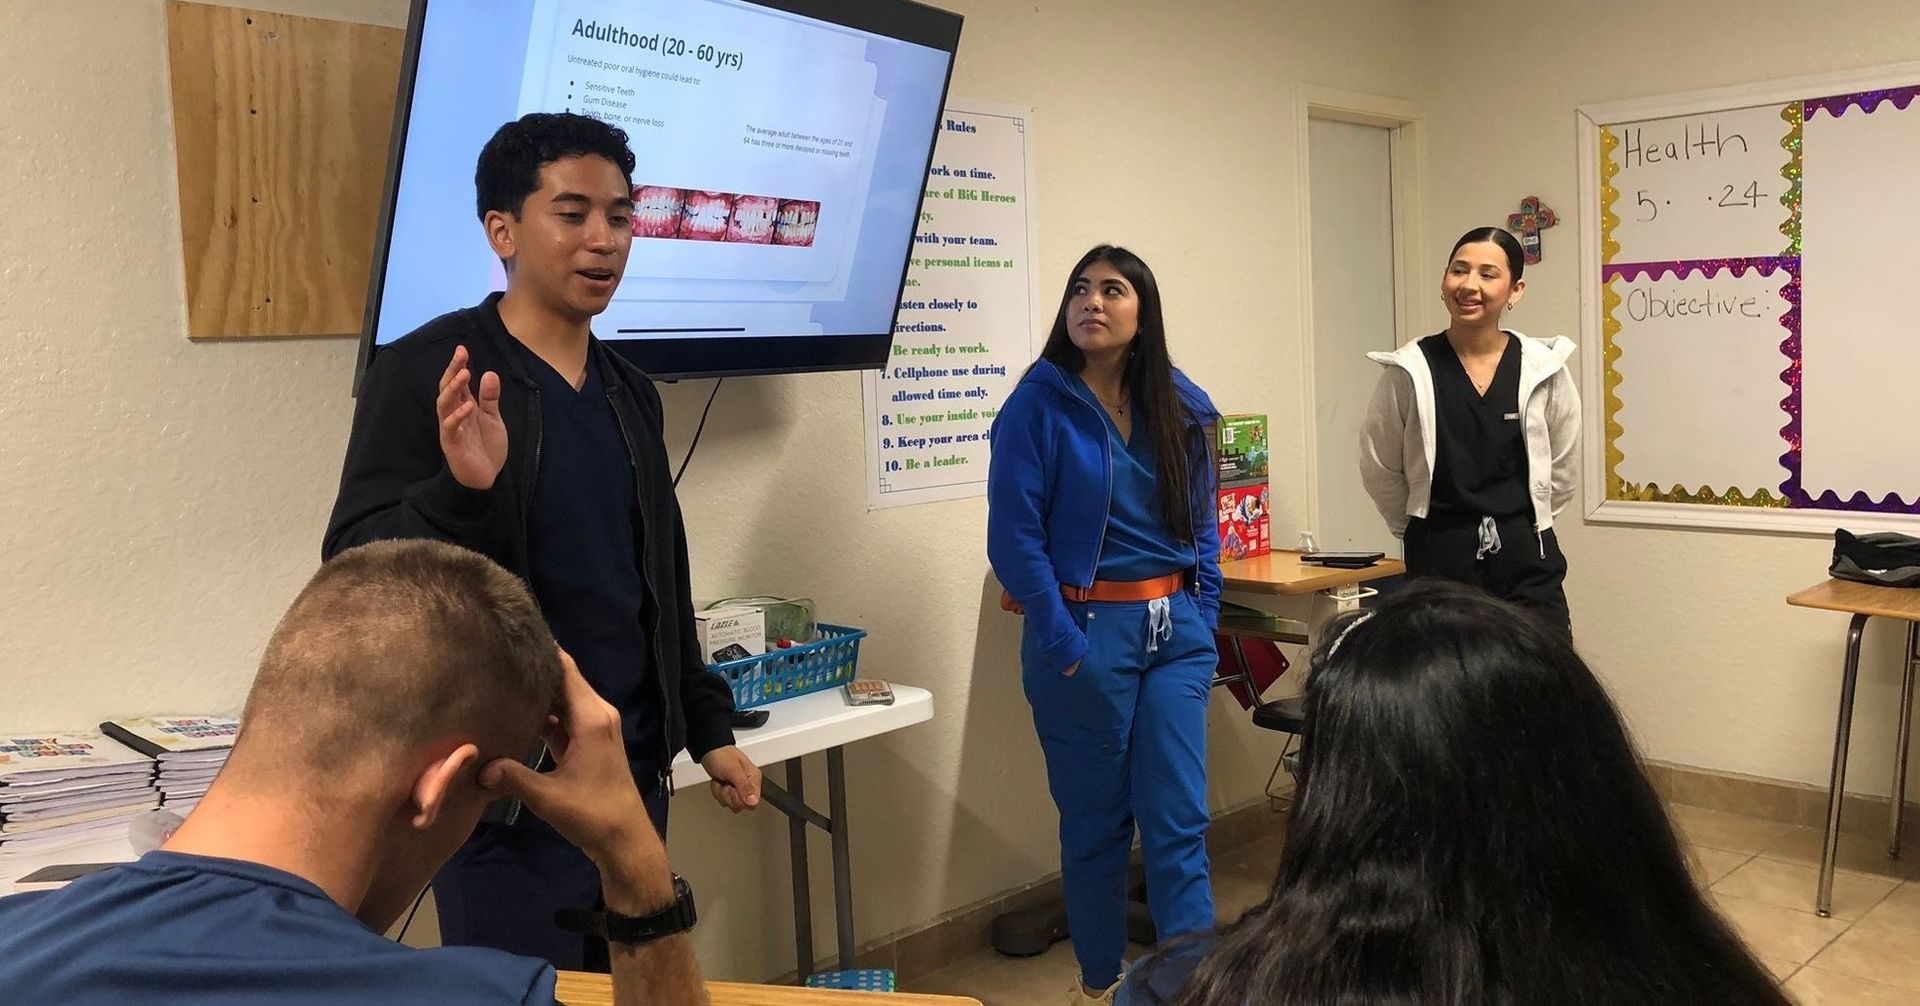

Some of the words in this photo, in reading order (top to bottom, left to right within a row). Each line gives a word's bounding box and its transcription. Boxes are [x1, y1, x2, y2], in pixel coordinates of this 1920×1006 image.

[572, 18, 659, 51] Adulthood
[662, 36, 685, 57] (20
[697, 44, 714, 62] 60
[716, 51, 743, 71] yrs)
[567, 54, 602, 68] Untreated
[603, 61, 620, 72] poor
[621, 64, 634, 74] oral
[635, 67, 660, 79] hygiene
[661, 71, 679, 81] could
[679, 73, 692, 83] lead
[585, 81, 615, 94] Sensitive
[617, 86, 635, 97] Teeth
[583, 95, 600, 104] Gum
[601, 98, 627, 109] Disease
[633, 117, 650, 126] nerve
[652, 118, 664, 127] loss
[946, 119, 976, 133] Rules
[1624, 122, 1748, 168] Health
[931, 165, 950, 177] ork
[953, 169, 967, 178] on
[970, 167, 996, 180] time.
[924, 189, 940, 198] are
[943, 188, 954, 199] of
[958, 188, 978, 201] BiG
[981, 191, 1016, 204] Heroes
[915, 232, 939, 243] with
[942, 236, 966, 247] your
[969, 235, 998, 246] team.
[924, 256, 970, 269] personal
[973, 256, 1001, 268] items
[1003, 257, 1013, 268] at
[899, 299, 925, 310] isten
[928, 298, 963, 312] closely
[967, 299, 978, 309] to
[894, 321, 946, 333] irections.
[893, 344, 908, 356] Be
[911, 343, 941, 357] ready
[944, 344, 956, 354] to
[959, 342, 989, 354] work.
[880, 367, 891, 379] 7.
[894, 366, 949, 381] Cellphone
[952, 367, 969, 377] use
[972, 364, 1006, 377] during
[892, 388, 935, 402] allowed
[938, 388, 962, 399] time
[964, 387, 988, 400] only.
[881, 414, 893, 426] 8.
[896, 413, 917, 425] Use
[919, 412, 944, 426] your
[947, 409, 978, 422] inside
[882, 437, 894, 449] 9.
[897, 436, 926, 449] Keep
[928, 435, 953, 448] your
[956, 433, 979, 443] area
[981, 429, 990, 440] cl
[885, 460, 902, 472] 10.
[906, 457, 922, 470] Be
[923, 459, 930, 468] a
[933, 453, 969, 468] leader.
